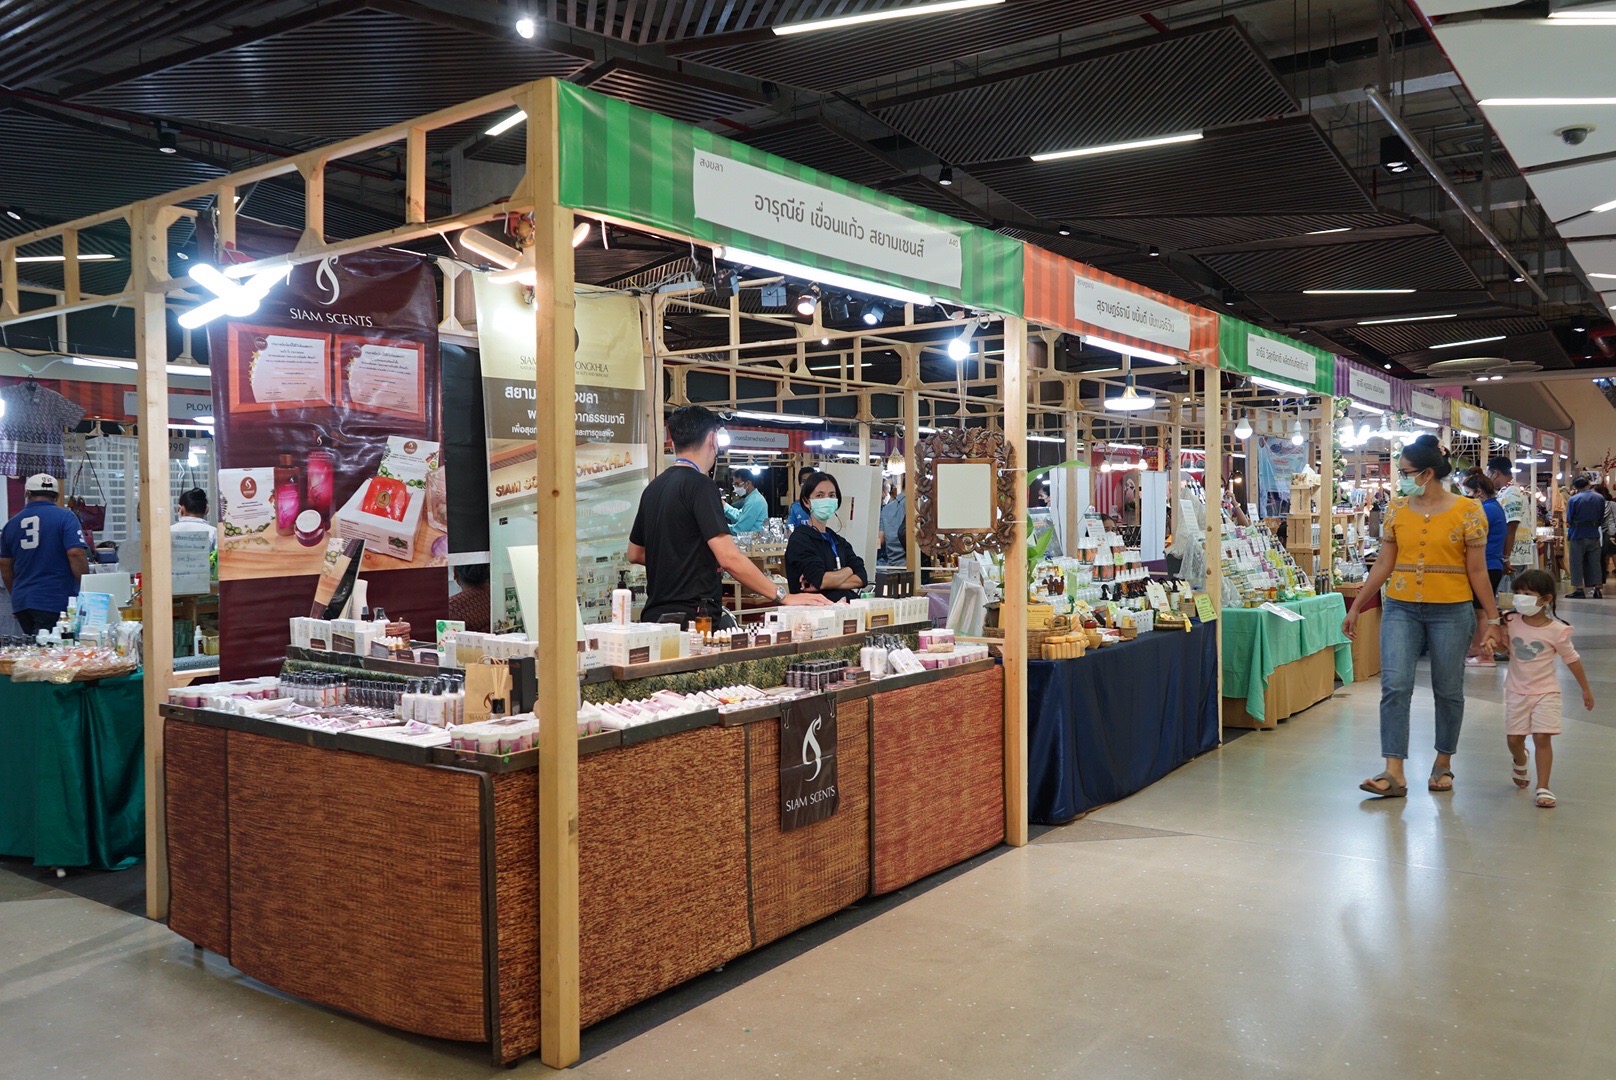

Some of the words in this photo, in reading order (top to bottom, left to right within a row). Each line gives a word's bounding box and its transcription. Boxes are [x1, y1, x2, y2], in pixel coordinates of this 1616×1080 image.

[699, 157, 724, 173] สงขลา
[754, 193, 805, 223] อารุณีย์
[810, 202, 865, 240] เขื่อนแก้ว
[289, 307, 323, 323] SIAM
[325, 312, 373, 328] SCENTS
[575, 361, 609, 372] ONGKHLA
[504, 386, 537, 400] สยาม
[575, 451, 632, 477] ONGKHLA
[20, 515, 40, 550] 3
[785, 796, 808, 812] SIAM
[809, 785, 836, 805] SCENTS
